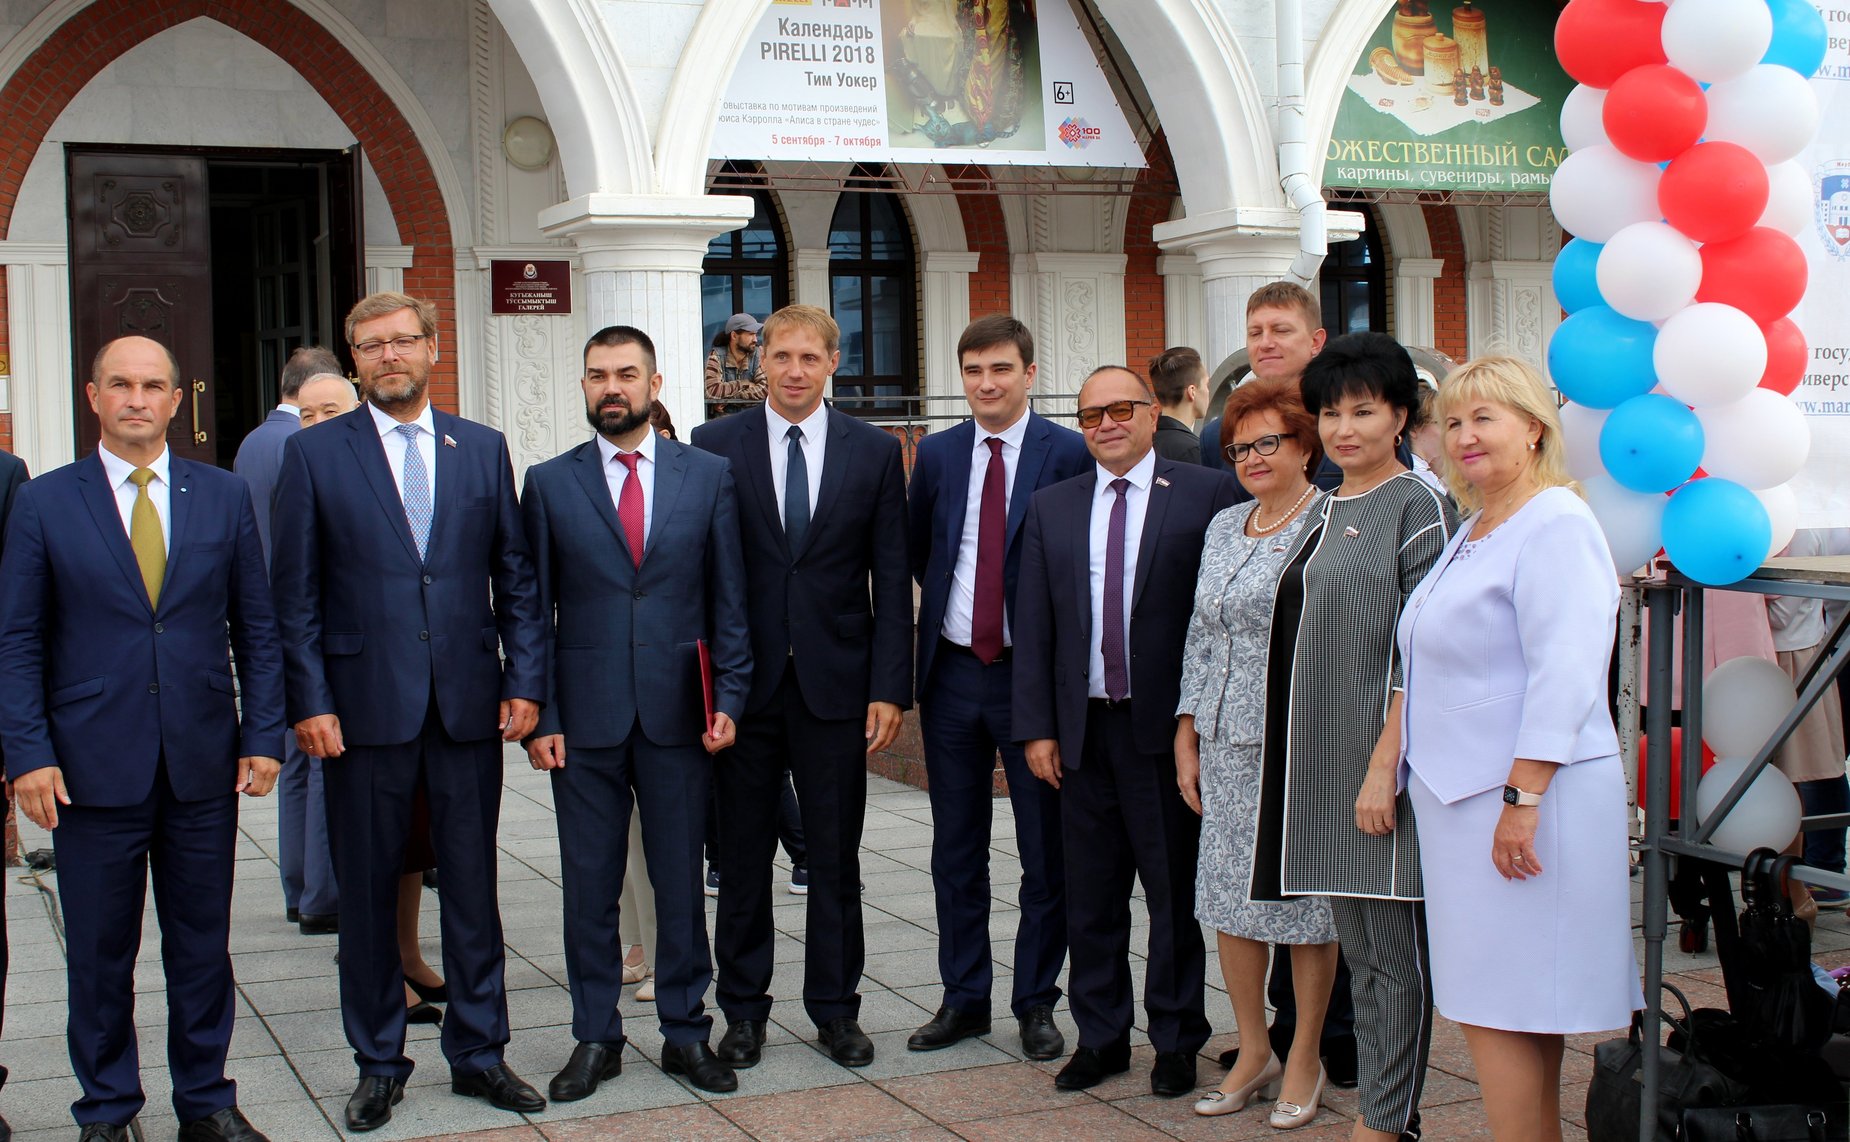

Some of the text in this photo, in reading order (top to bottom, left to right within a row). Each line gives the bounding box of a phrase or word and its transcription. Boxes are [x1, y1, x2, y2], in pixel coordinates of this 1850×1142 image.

[778, 17, 874, 42] Календарь
[761, 41, 875, 64] PIRELLI 2018
[1828, 37, 1850, 56] ве
[804, 71, 877, 91] Тим Уокер
[1056, 85, 1071, 101] 6+
[769, 103, 780, 111] по
[781, 103, 818, 112] мотивам
[819, 104, 878, 114] произведений
[742, 114, 783, 125] Кэрролла
[823, 118, 852, 127] стране
[1082, 127, 1101, 135] 100
[772, 134, 778, 145] 5
[781, 135, 825, 147] сентября
[834, 136, 840, 146] 7
[843, 136, 882, 148] октября
[1337, 167, 1414, 184] картины,
[1420, 169, 1505, 187] сувениры,
[1814, 347, 1850, 365] госу
